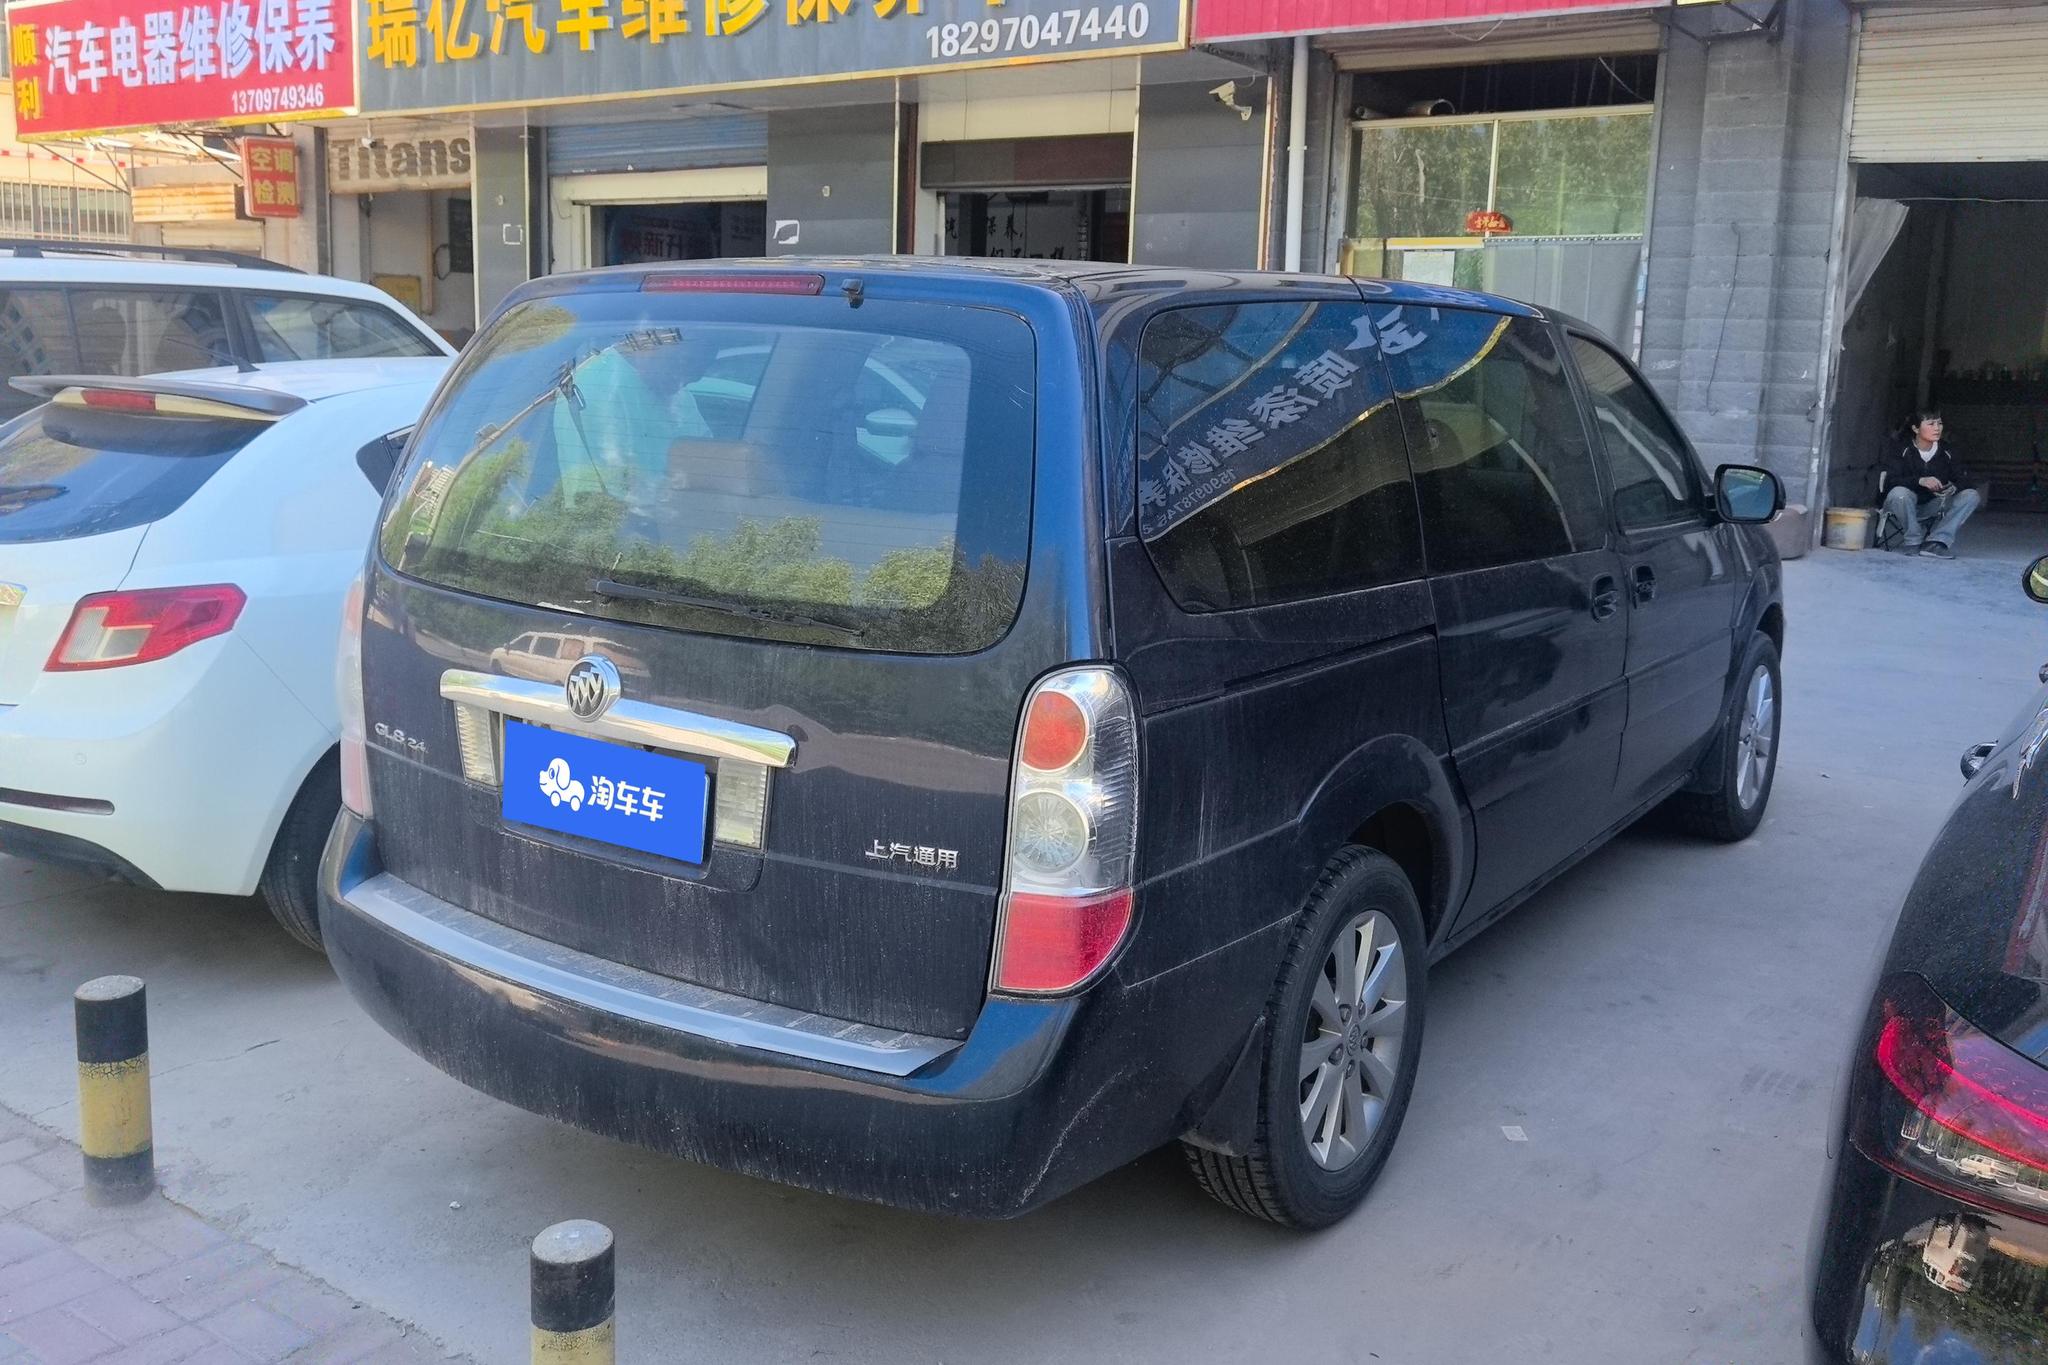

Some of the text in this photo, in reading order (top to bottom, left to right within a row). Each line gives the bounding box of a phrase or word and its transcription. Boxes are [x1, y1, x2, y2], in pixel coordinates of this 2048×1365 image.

[926, 2, 1150, 58] 18297047440
[45, 0, 335, 95] 汽车电器维修保养
[12, 23, 42, 120] 顺利
[231, 82, 325, 114] 13709749346
[251, 146, 294, 172] 空调
[254, 180, 296, 206] 检测
[864, 839, 959, 869] 上汽通用
